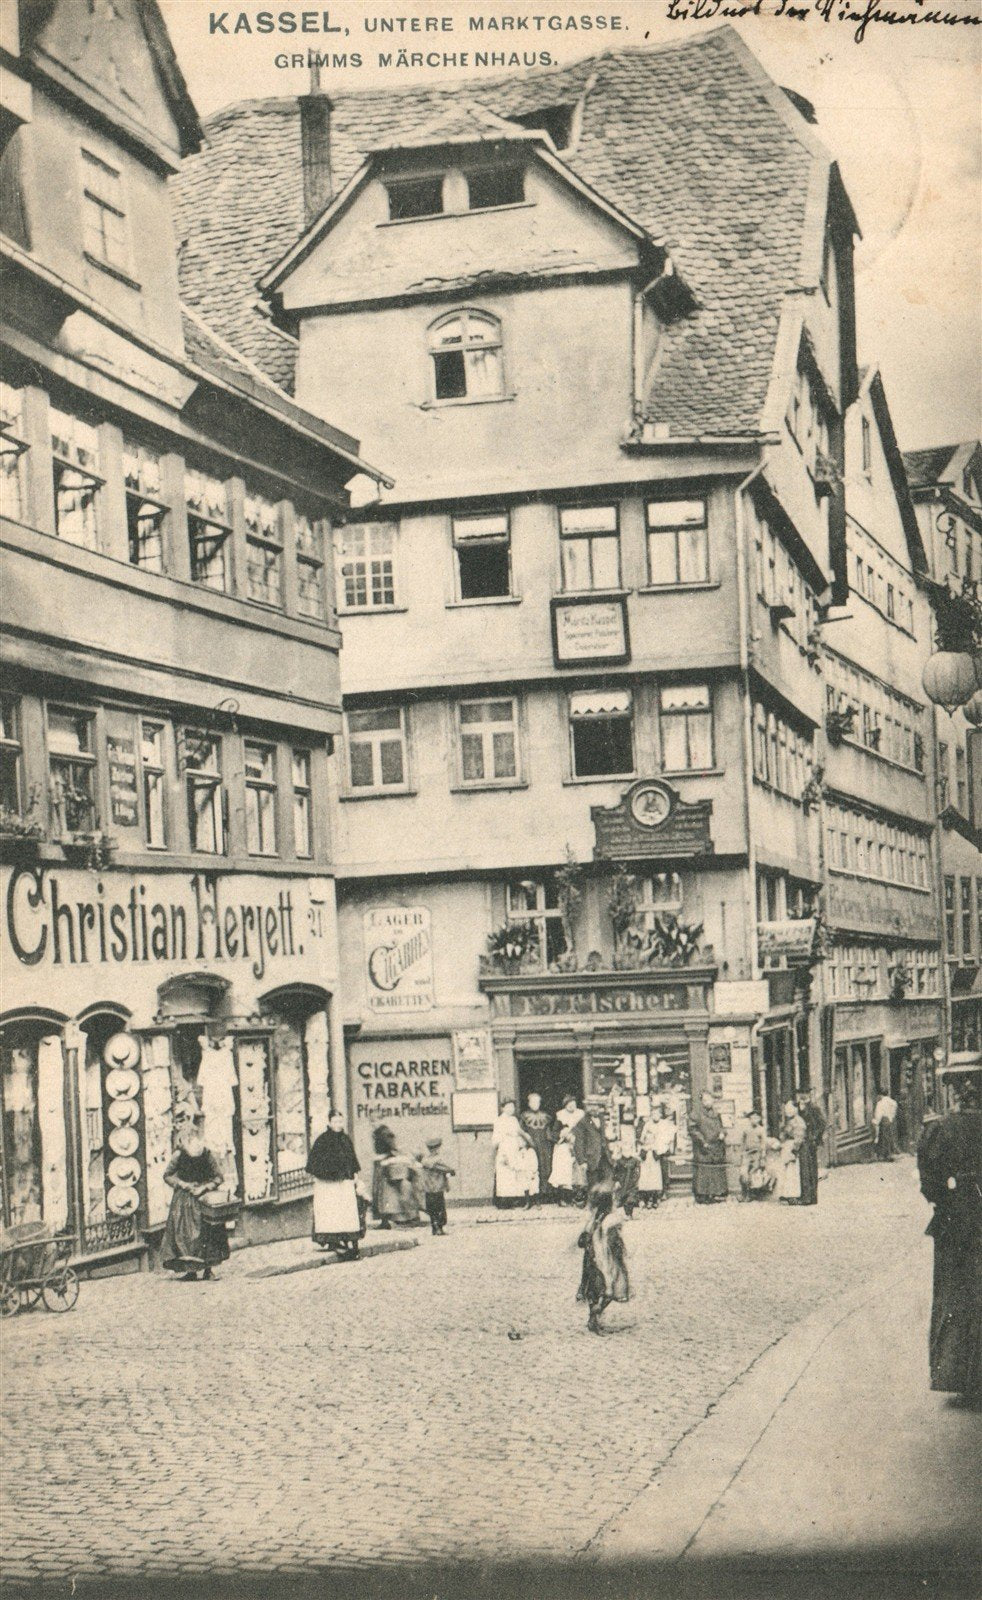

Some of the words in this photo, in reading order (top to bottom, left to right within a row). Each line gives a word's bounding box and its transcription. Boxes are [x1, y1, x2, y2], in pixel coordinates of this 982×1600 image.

[6, 864, 188, 967] Christian
[189, 872, 305, 980] Herjett.
[370, 911, 424, 927] LAGER
[362, 1080, 445, 1100] TABAKE.
[357, 1103, 393, 1119] Pfeifen
